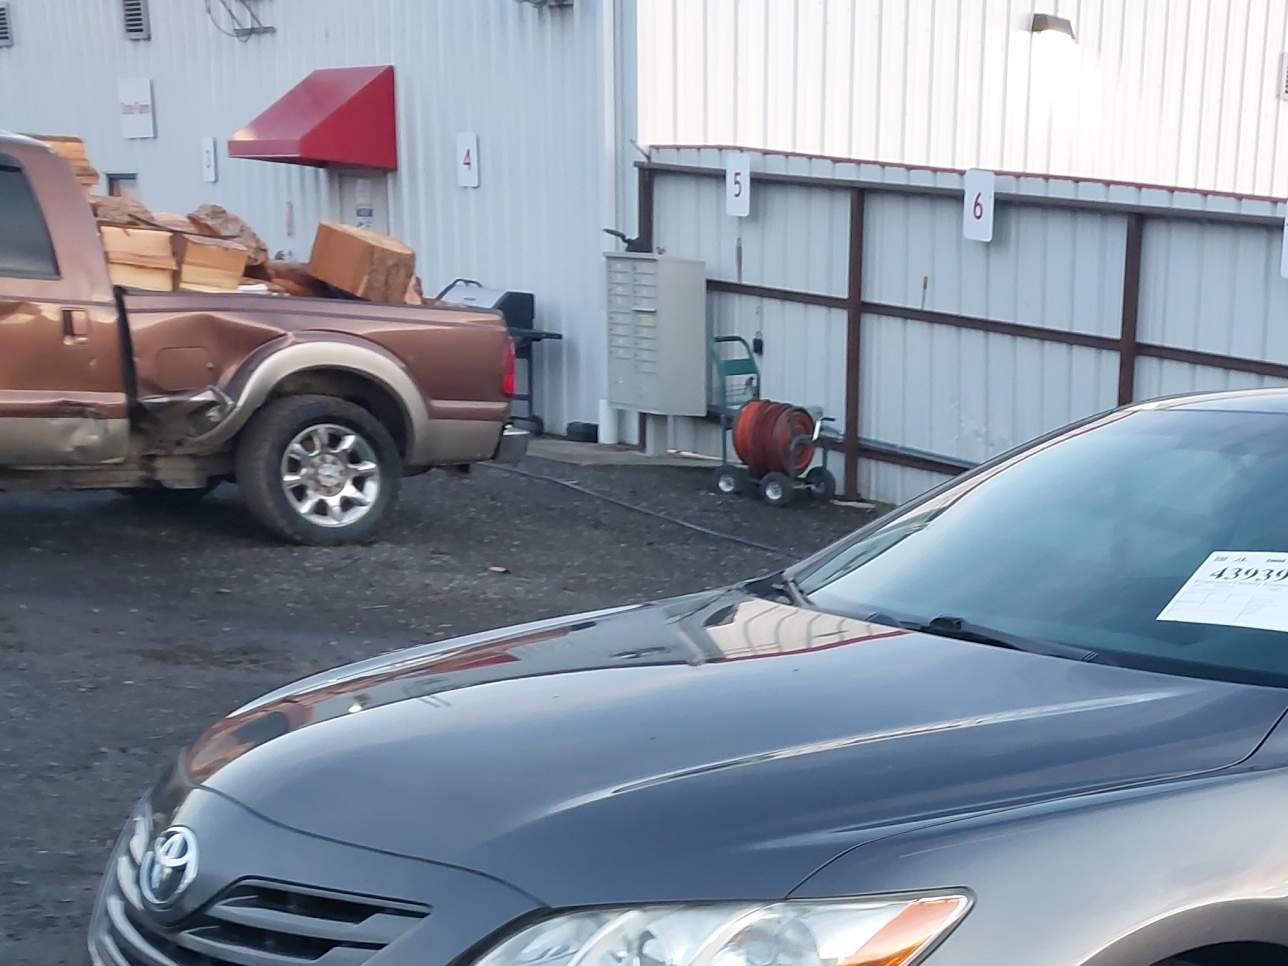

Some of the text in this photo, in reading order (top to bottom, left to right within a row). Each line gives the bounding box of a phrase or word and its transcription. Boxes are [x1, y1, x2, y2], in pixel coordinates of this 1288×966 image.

[463, 148, 471, 171] 4
[733, 172, 742, 198] 5
[973, 191, 983, 220] 6
